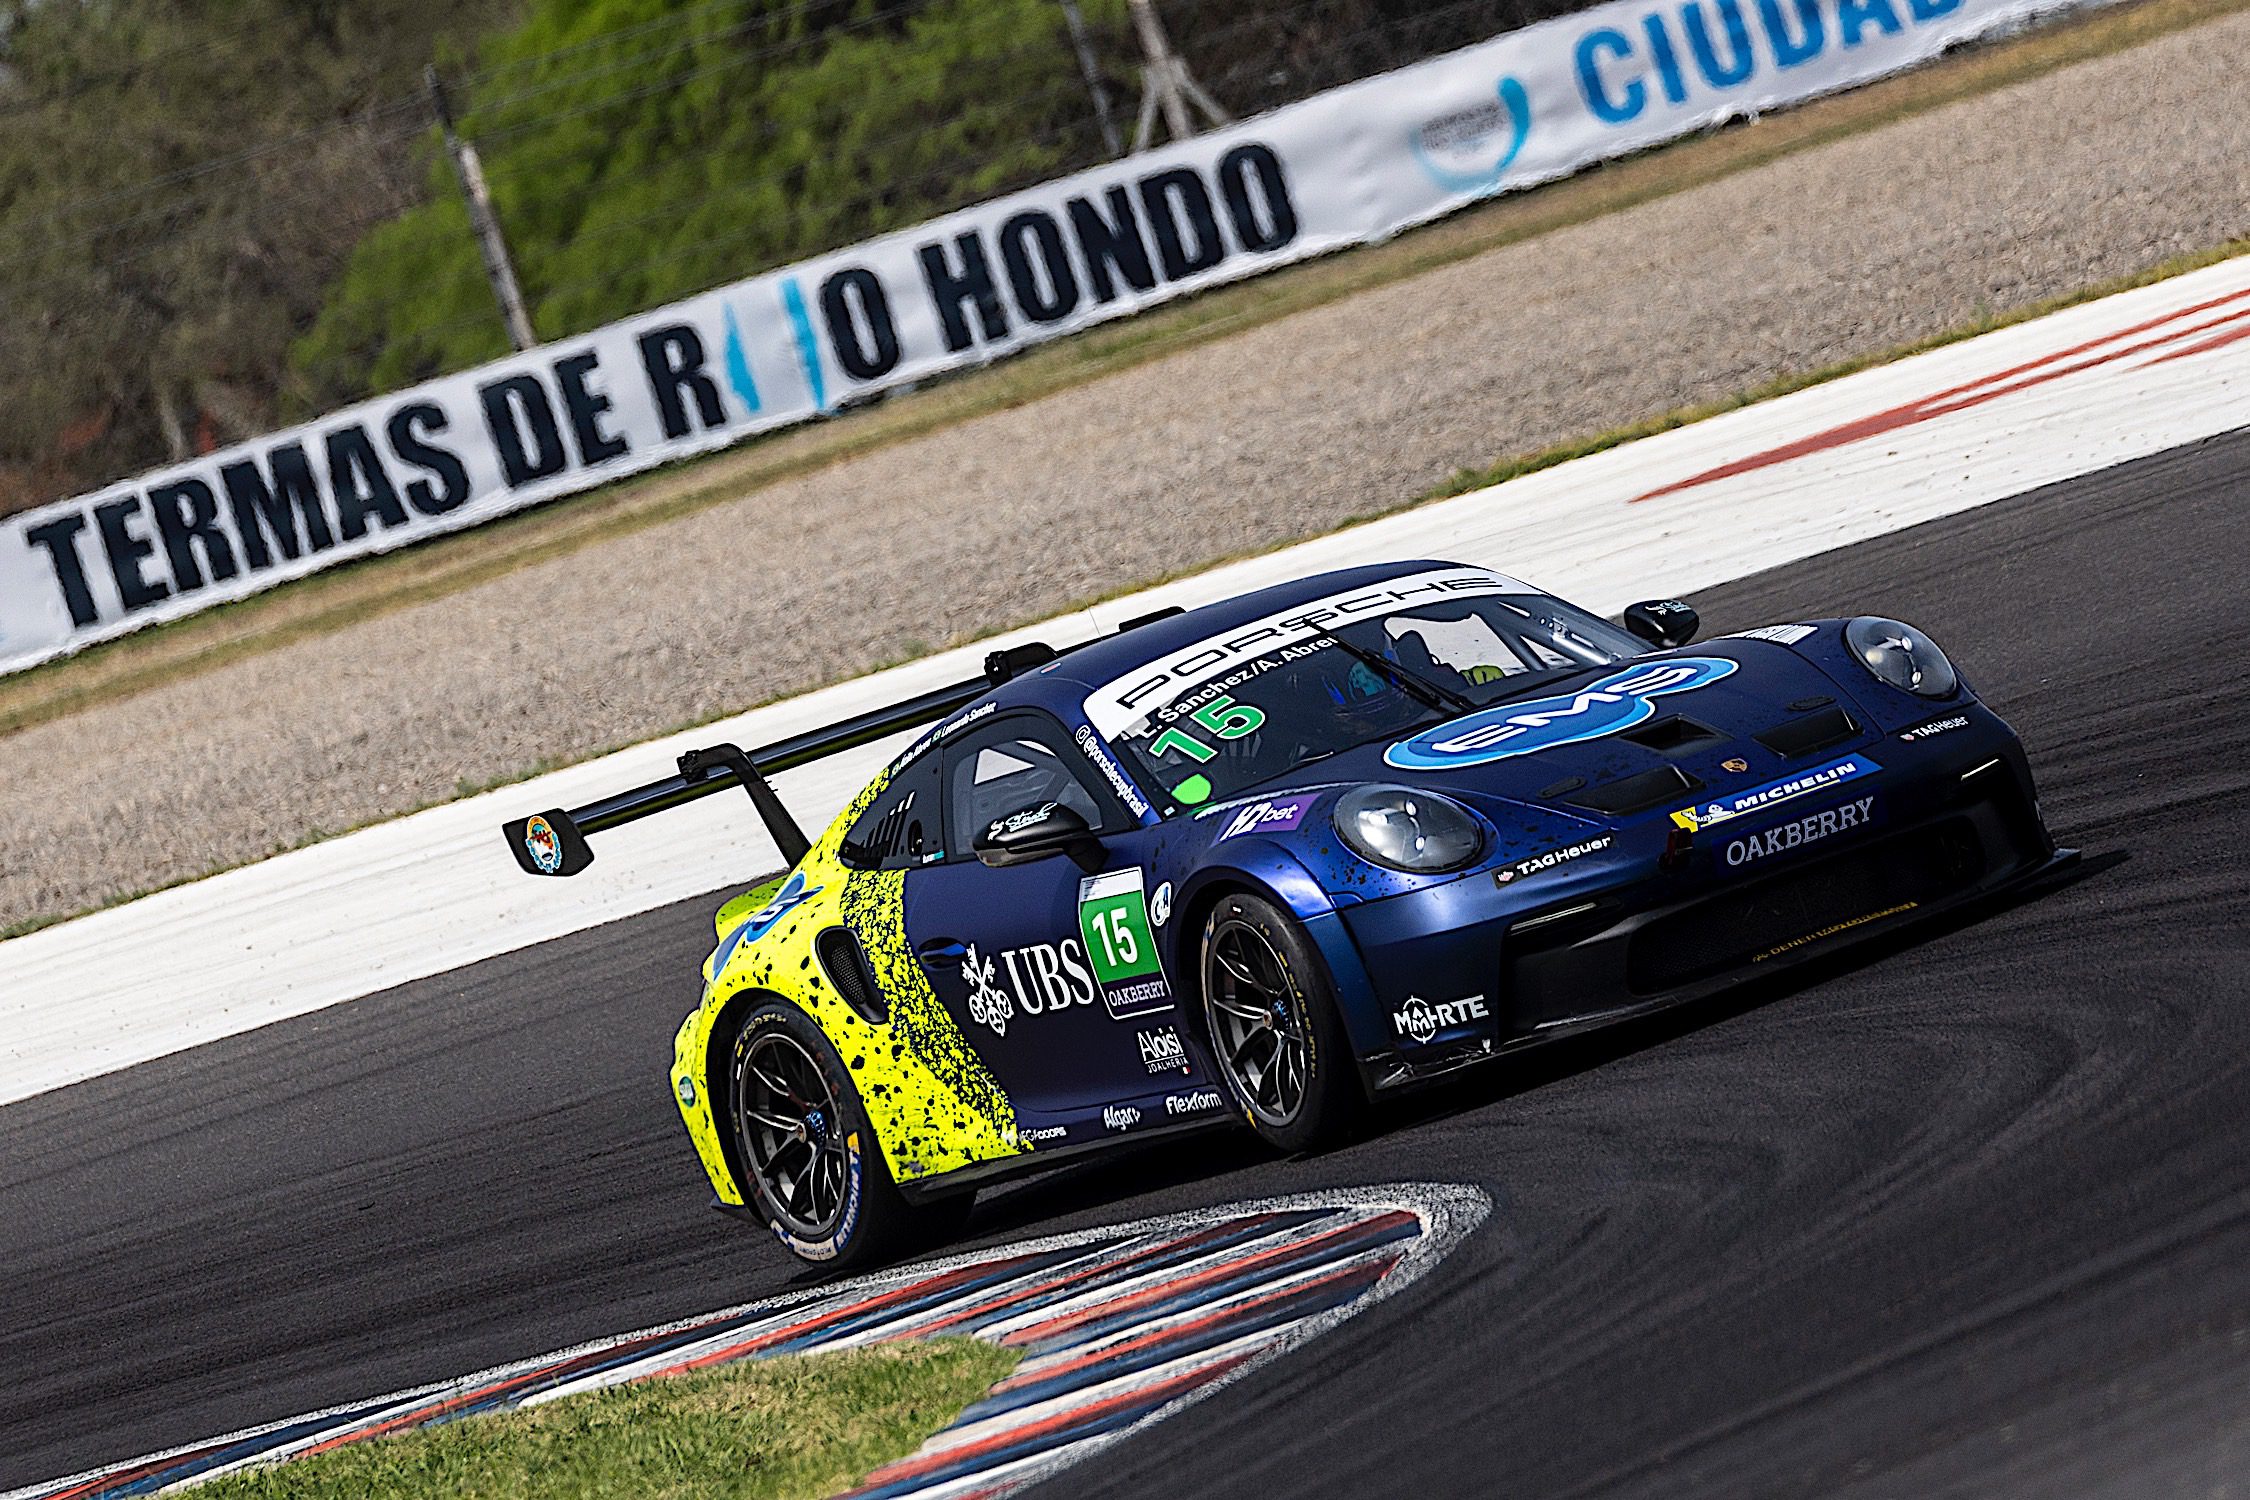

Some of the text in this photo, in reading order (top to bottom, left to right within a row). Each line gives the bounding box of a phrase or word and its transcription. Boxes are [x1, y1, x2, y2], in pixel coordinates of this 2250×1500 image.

[1573, 0, 1967, 124] CIUD
[26, 403, 470, 628] TERMAS
[478, 350, 628, 489] DE
[916, 143, 1299, 353] HONDO
[1116, 576, 1504, 709] PORSCHE
[1148, 694, 1267, 764] 15
[1735, 762, 1857, 811] MICHELIN
[1726, 795, 1875, 867] OAKBERRY
[1090, 906, 1140, 968] 15
[1001, 938, 1095, 1015] UBS
[1108, 979, 1167, 1008] OAKBERRY
[1137, 1025, 1184, 1062] Aloisi
[1165, 1091, 1223, 1116] Flexform
